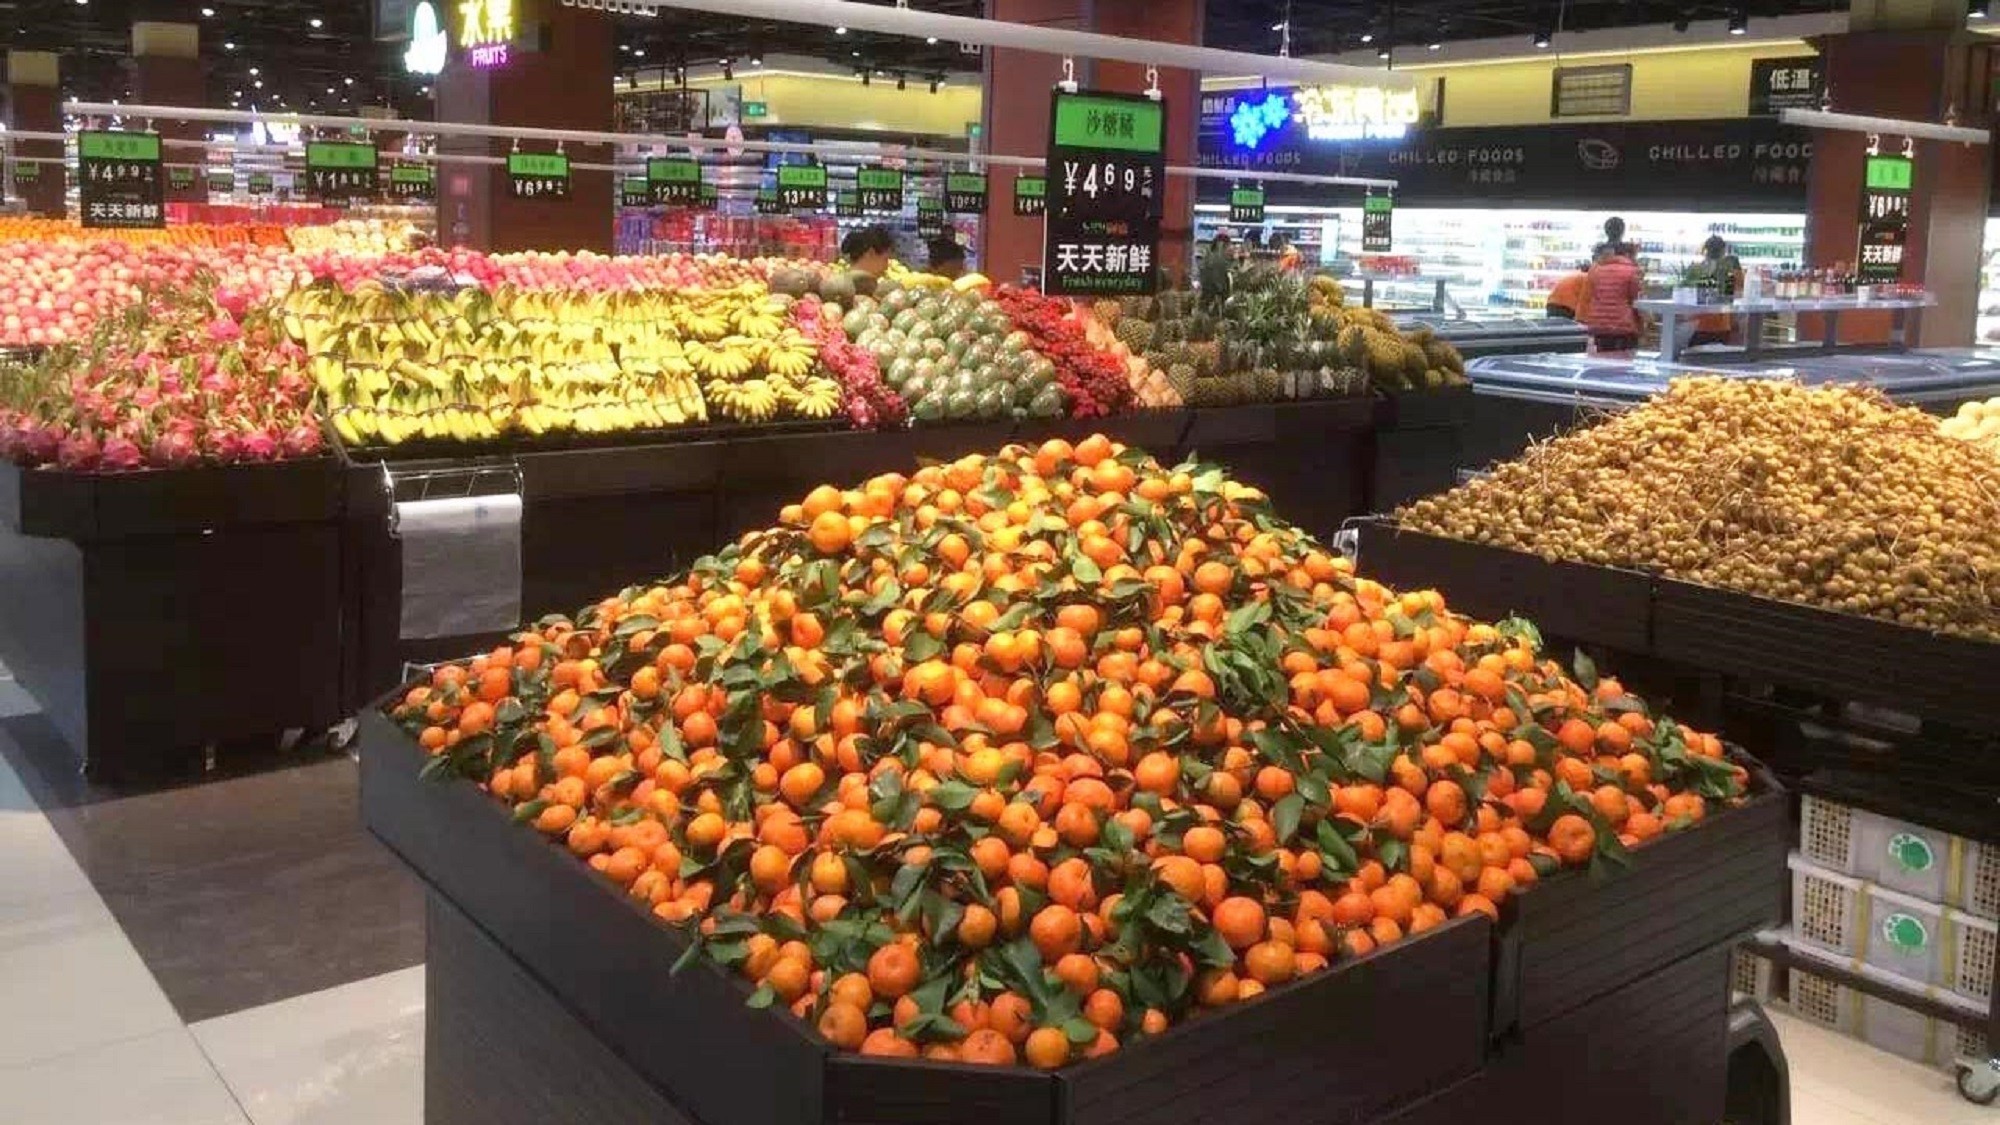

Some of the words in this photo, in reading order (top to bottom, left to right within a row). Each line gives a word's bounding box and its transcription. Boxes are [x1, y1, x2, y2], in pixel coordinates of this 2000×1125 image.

[472, 45, 507, 67] FRUITS
[1770, 69, 1818, 89] 低温
[1388, 149, 1457, 164] CHILLED
[1468, 147, 1524, 164] FOODS
[1649, 145, 1740, 160] CHILLED
[90, 202, 159, 220] 天天新鲜
[1057, 244, 1151, 273] 天天新鲜
